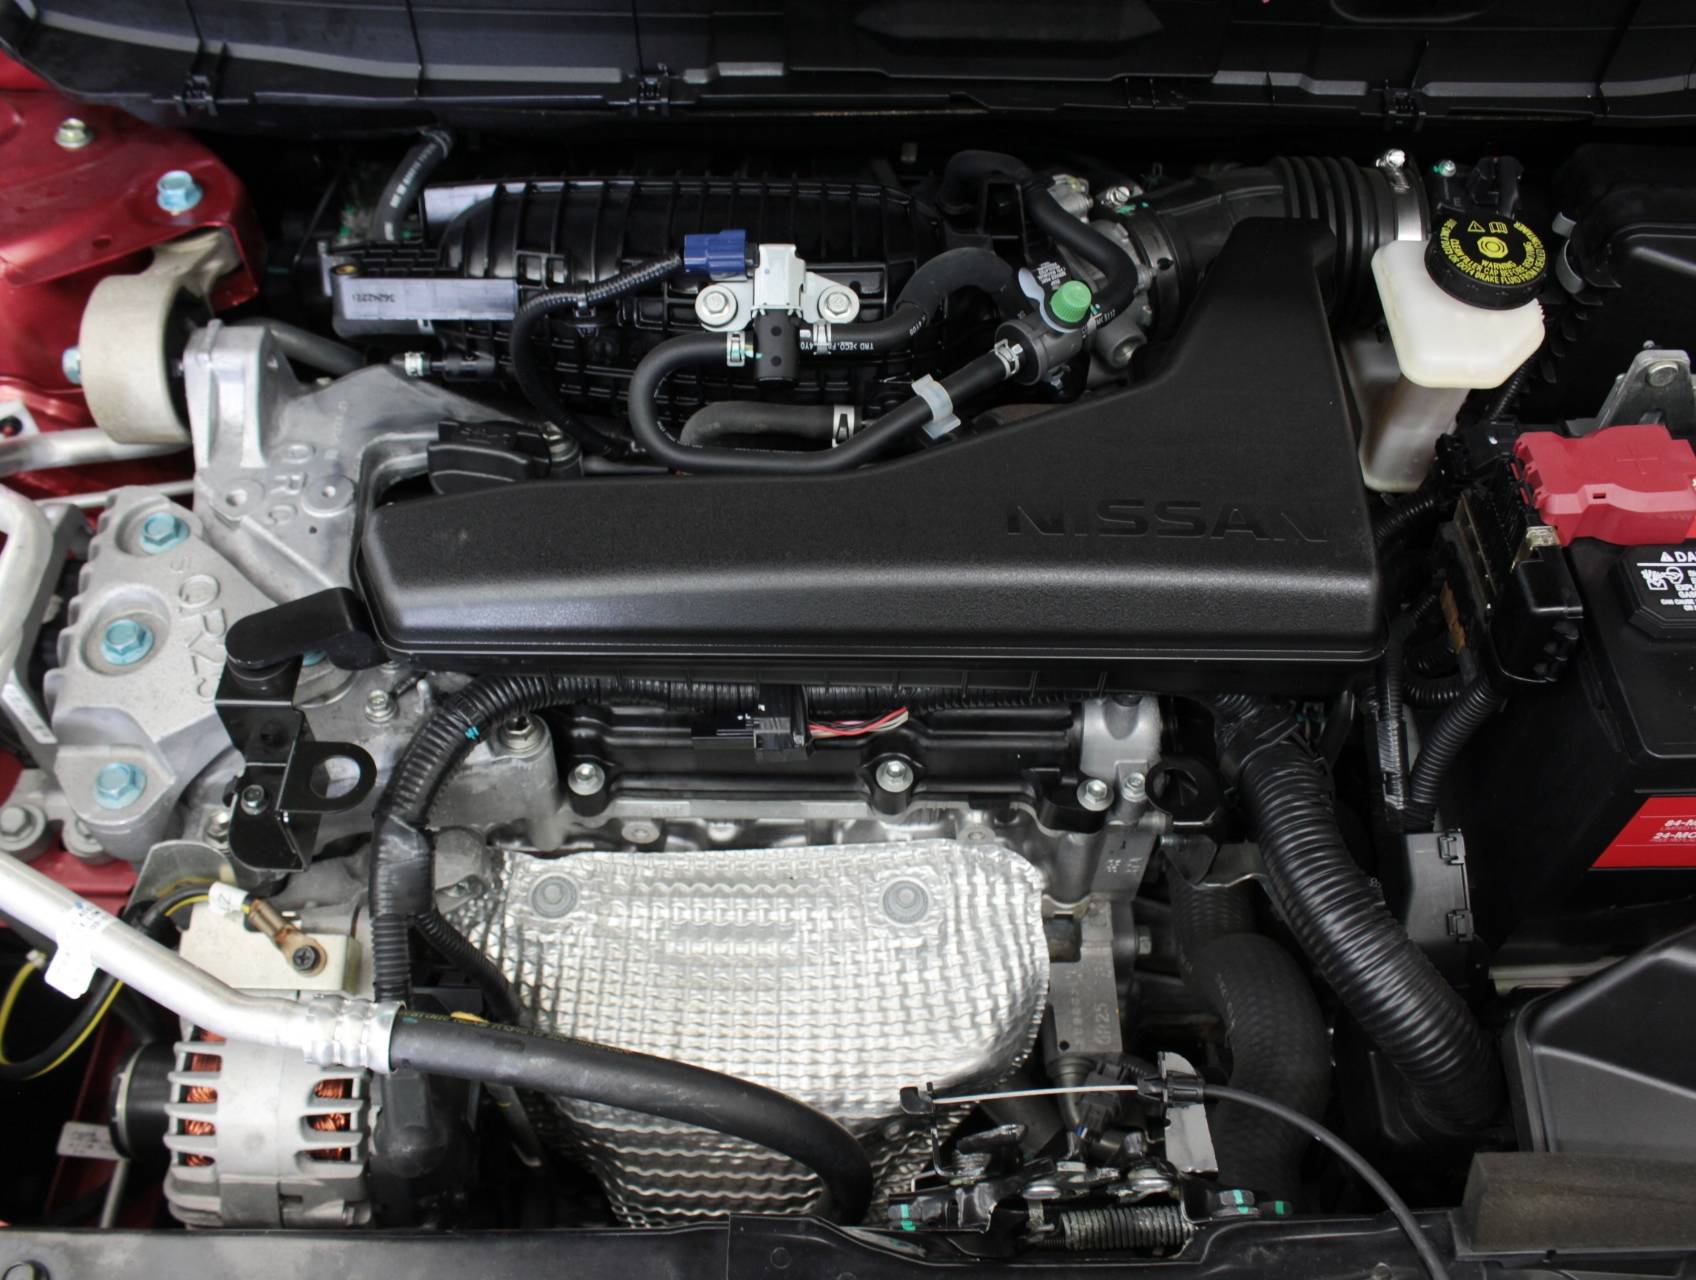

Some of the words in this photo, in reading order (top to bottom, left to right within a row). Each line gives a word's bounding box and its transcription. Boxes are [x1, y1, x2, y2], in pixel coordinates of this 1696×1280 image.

[1450, 239, 1464, 256] CLEAN
[1460, 256, 1483, 272] FILLER
[1484, 268, 1499, 276] CAP
[1500, 265, 1527, 277] BEFORE
[1481, 259, 1516, 270] WARNING
[1456, 262, 1475, 275] DOT4
[1475, 271, 1500, 284] BRAKE
[1501, 276, 1520, 284] FLUID
[1007, 499, 1328, 543] NISSAN
[1674, 551, 1696, 562] DA
